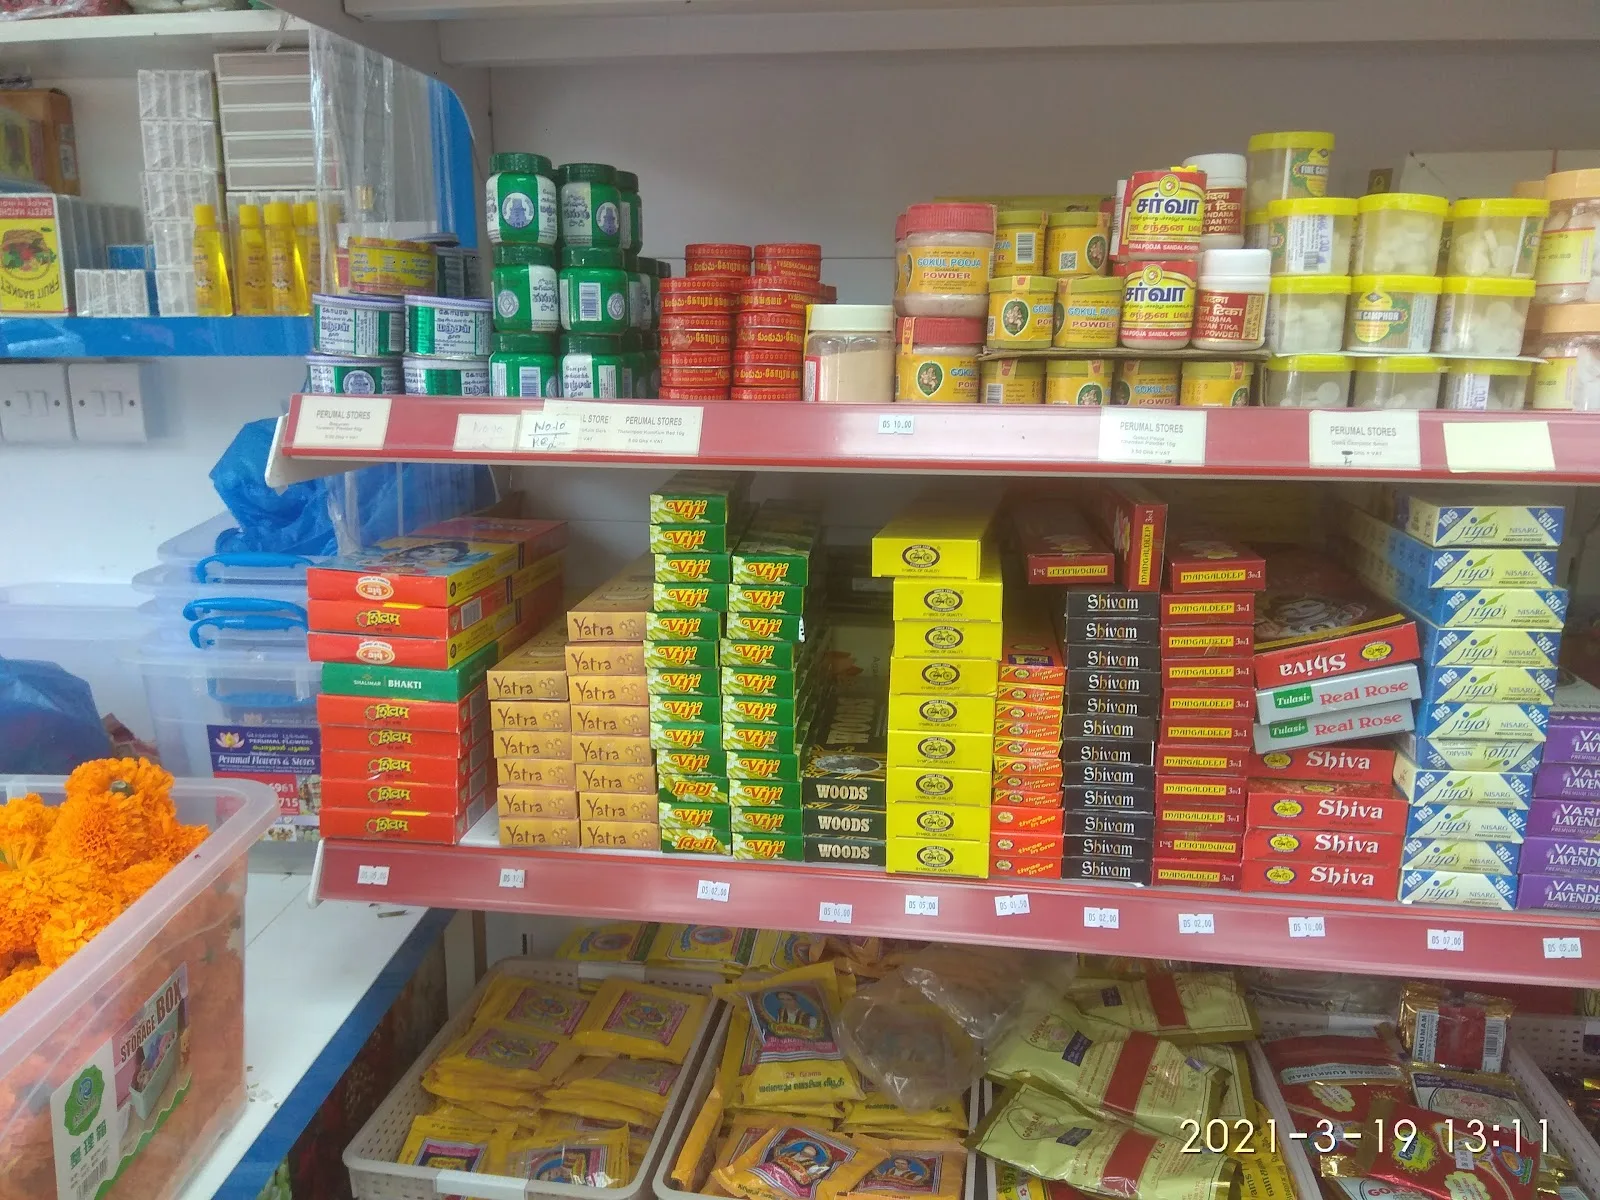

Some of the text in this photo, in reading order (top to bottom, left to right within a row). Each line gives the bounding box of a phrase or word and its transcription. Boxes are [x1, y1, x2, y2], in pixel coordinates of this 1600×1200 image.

[1136, 192, 1199, 215] சர்வா
[917, 258, 981, 267] GOKUL POOJA
[1068, 307, 1097, 316] GOKUL
[1148, 330, 1169, 338] SANDAL
[316, 410, 371, 420] PERUMAL STORES
[625, 416, 682, 426] PERUMAL STORES
[1120, 421, 1184, 433] PERUMAL STORES
[1330, 426, 1397, 437] PERUMAL STORES
[665, 500, 708, 520] Viji
[1440, 509, 1458, 527] 105
[664, 530, 706, 549] Viji
[668, 560, 710, 579] Viji
[1434, 552, 1454, 570] 105
[746, 563, 789, 583] Viji
[668, 589, 709, 607] Viji
[742, 590, 785, 610] Viji
[1087, 594, 1139, 611] Shivam
[1448, 591, 1466, 610] 105
[1170, 603, 1233, 613] MANGALDEEP
[573, 617, 614, 636] Yatra
[660, 618, 700, 637] Viji
[741, 618, 782, 637] Viji
[1086, 622, 1137, 640] Shivam
[1439, 632, 1458, 650] 105
[571, 651, 611, 670] Yatra
[656, 646, 698, 665] Viji
[734, 645, 775, 664] Viji
[1087, 650, 1139, 668] Shivam
[1170, 667, 1233, 677] MANGALDEEP
[1279, 653, 1347, 676] Shiva
[388, 679, 422, 690] BHAKTI
[493, 676, 533, 695] Yatra
[661, 673, 701, 691] Viji
[736, 674, 777, 694] Viji
[1088, 674, 1140, 692] Shivam
[1438, 669, 1457, 687] 105
[576, 681, 615, 700] Yatra
[1276, 680, 1409, 706] Tulasi Real Rose
[664, 701, 703, 719] Viji
[737, 701, 777, 720] Viji
[1087, 698, 1138, 716] Shivam
[1431, 705, 1451, 723] 105
[498, 707, 537, 726] Yatra
[578, 711, 617, 730] Yatra
[1271, 712, 1402, 736] Tulasi Real Rose
[1082, 720, 1134, 737] Shivam
[500, 736, 540, 755] Yatra
[664, 729, 704, 747] Viji
[736, 729, 777, 748] Viji
[252, 756, 281, 765] Flowers
[580, 742, 619, 761] Yatra
[1081, 745, 1131, 761] Shivam
[1306, 751, 1371, 770] Shiva
[503, 762, 542, 782] Yatra
[670, 754, 709, 772] Viji
[583, 770, 622, 789] Yatra
[1083, 766, 1134, 785] Shivam
[1416, 772, 1435, 789] 105
[816, 784, 868, 800] WOODS
[1084, 790, 1134, 808] Shivam
[504, 793, 543, 813] Yatra
[586, 798, 626, 818] Yatra
[1317, 799, 1383, 820] Shiva
[1415, 803, 1433, 821] 105
[674, 809, 713, 827] Viji
[817, 815, 870, 832] WOODS
[1019, 815, 1043, 827] three
[1040, 815, 1056, 824] one
[1085, 816, 1134, 834] Shivam
[506, 825, 546, 845] Yatra
[587, 826, 626, 845] Yatra
[1314, 833, 1380, 854] Shiva
[818, 844, 870, 859] WOODS
[1018, 842, 1042, 854] three
[1040, 842, 1056, 850] one
[1083, 838, 1133, 857] Shivam
[1404, 838, 1423, 856] 105
[1555, 843, 1600, 854] VARN
[1017, 863, 1041, 874] three
[1037, 863, 1054, 872] one
[1081, 861, 1131, 877] Shivam
[1309, 866, 1374, 886] Shiva
[1404, 872, 1422, 890] 105
[1552, 880, 1600, 891] VARN
[1442, 937, 1461, 946] 07.00
[119, 978, 182, 1063] STORAGE BOX
